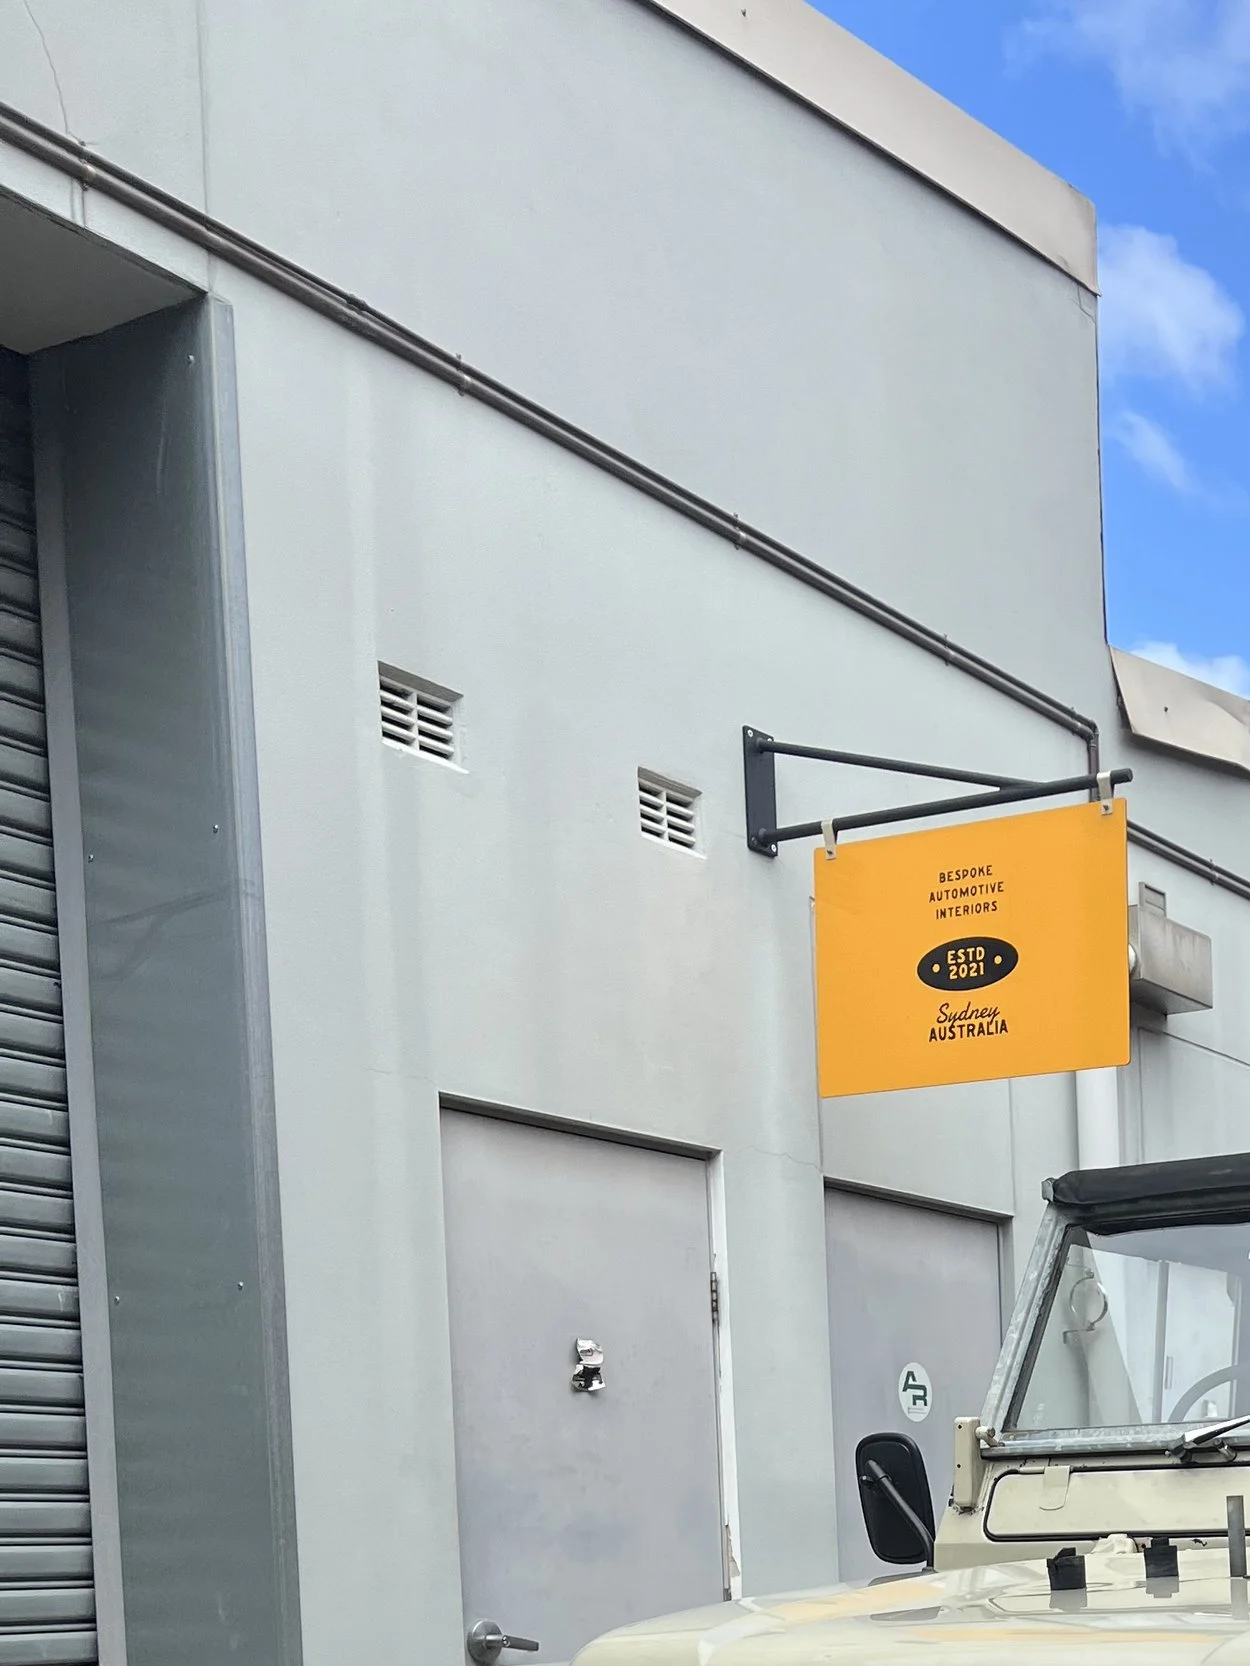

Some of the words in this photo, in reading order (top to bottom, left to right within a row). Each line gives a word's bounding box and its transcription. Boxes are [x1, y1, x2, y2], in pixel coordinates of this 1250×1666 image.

[939, 864, 993, 883] BESPOKE
[929, 881, 1004, 902] AUTOMOTIVE
[936, 901, 997, 919] INTERIORS
[947, 946, 985, 963] ESTD
[949, 963, 984, 980] 2021
[936, 1001, 1000, 1026] Sydney
[928, 1019, 1008, 1043] AUSTRALIA
